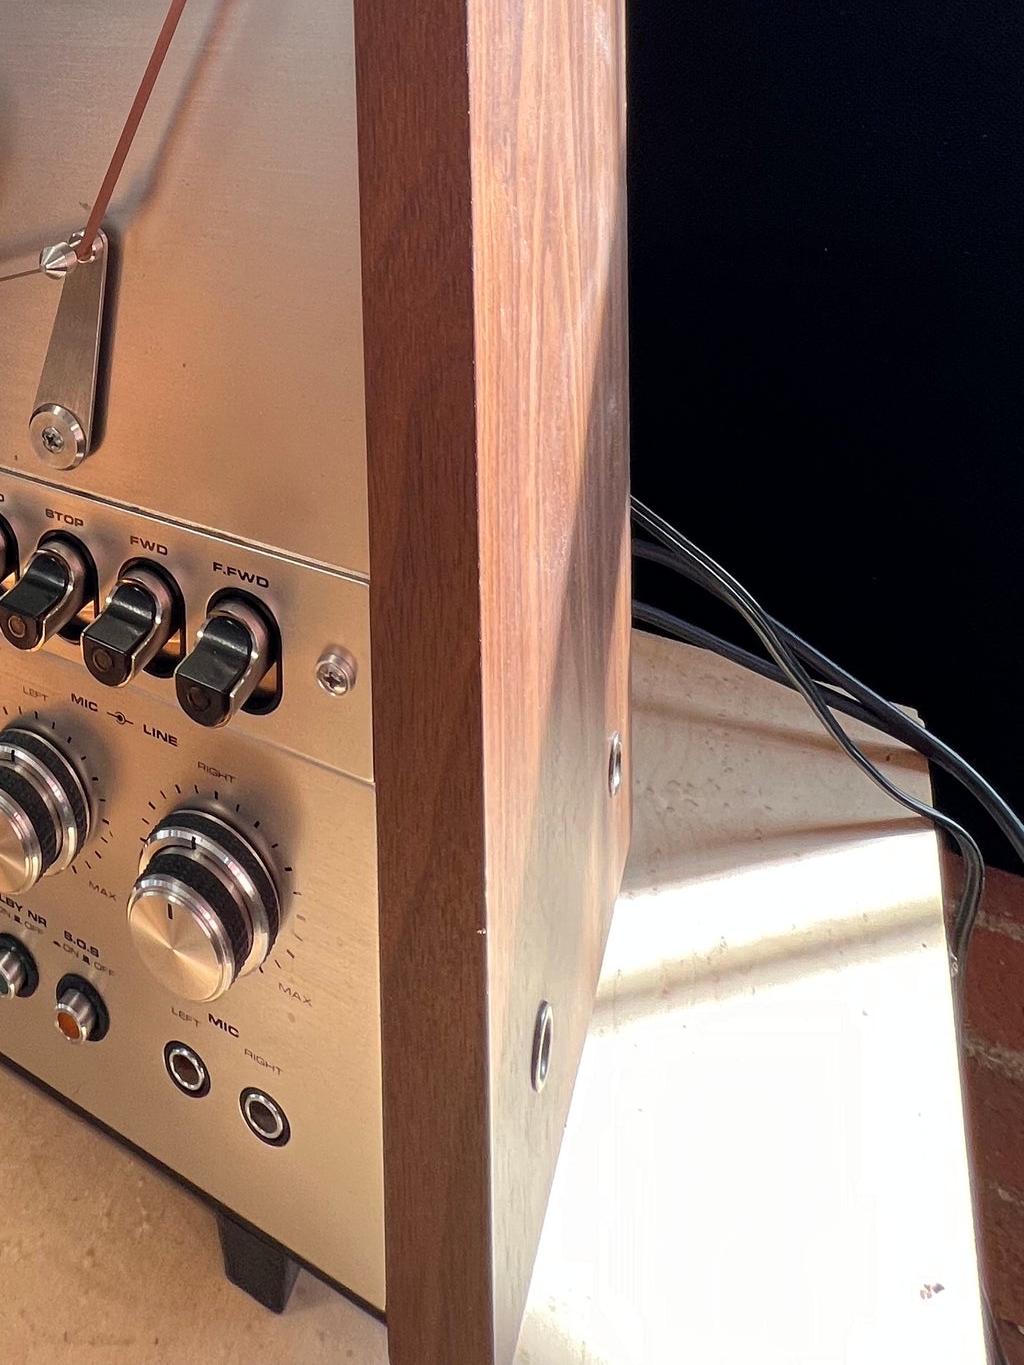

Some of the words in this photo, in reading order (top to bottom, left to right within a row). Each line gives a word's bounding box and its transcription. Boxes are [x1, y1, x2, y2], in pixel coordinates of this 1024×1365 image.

[45, 507, 84, 527] STOP
[129, 535, 169, 556] FWD
[212, 561, 270, 589] F.FWD
[22, 685, 49, 702] LEFT
[70, 692, 99, 712] MIC
[142, 723, 179, 747] LINE
[196, 760, 236, 783] RIGHT
[88, 880, 117, 902] MAX
[27, 909, 48, 928] NR
[62, 942, 79, 958] ON
[278, 982, 313, 1007] MAX
[170, 1005, 201, 1028] LEFT
[207, 1012, 240, 1038] MIC
[244, 1047, 284, 1076] RIGHT
